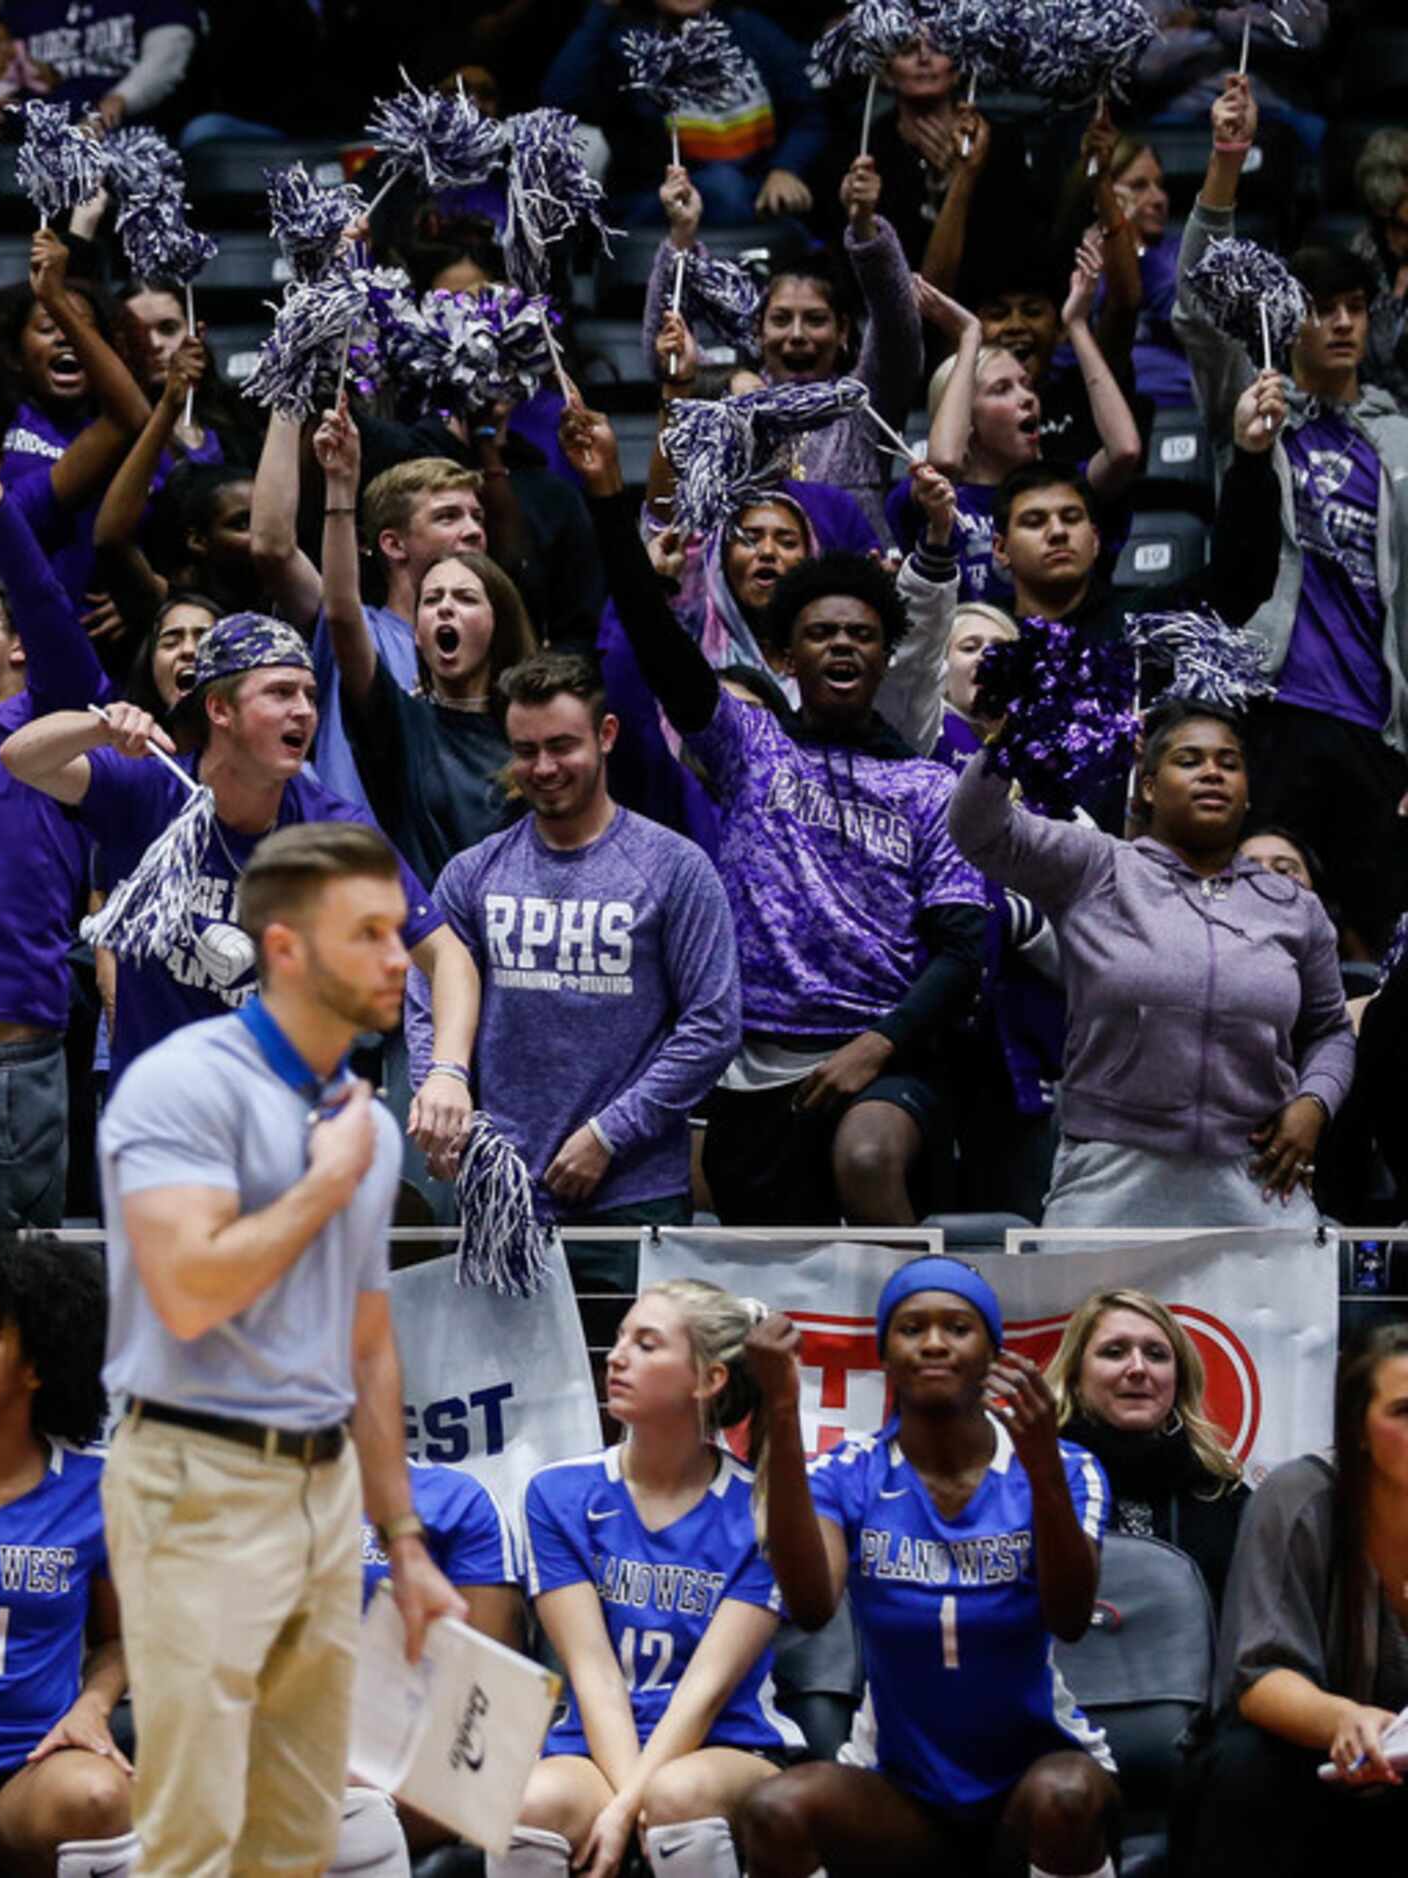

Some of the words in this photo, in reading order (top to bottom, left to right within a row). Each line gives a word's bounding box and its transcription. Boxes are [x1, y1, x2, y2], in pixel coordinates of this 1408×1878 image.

[484, 893, 635, 974] RPHS
[0, 1544, 78, 1593] WEST
[860, 1528, 950, 1587] PLANO
[951, 1531, 1032, 1585] WEST
[655, 1564, 727, 1617] WEST
[619, 1627, 674, 1692] 12
[939, 1595, 960, 1669] 1
